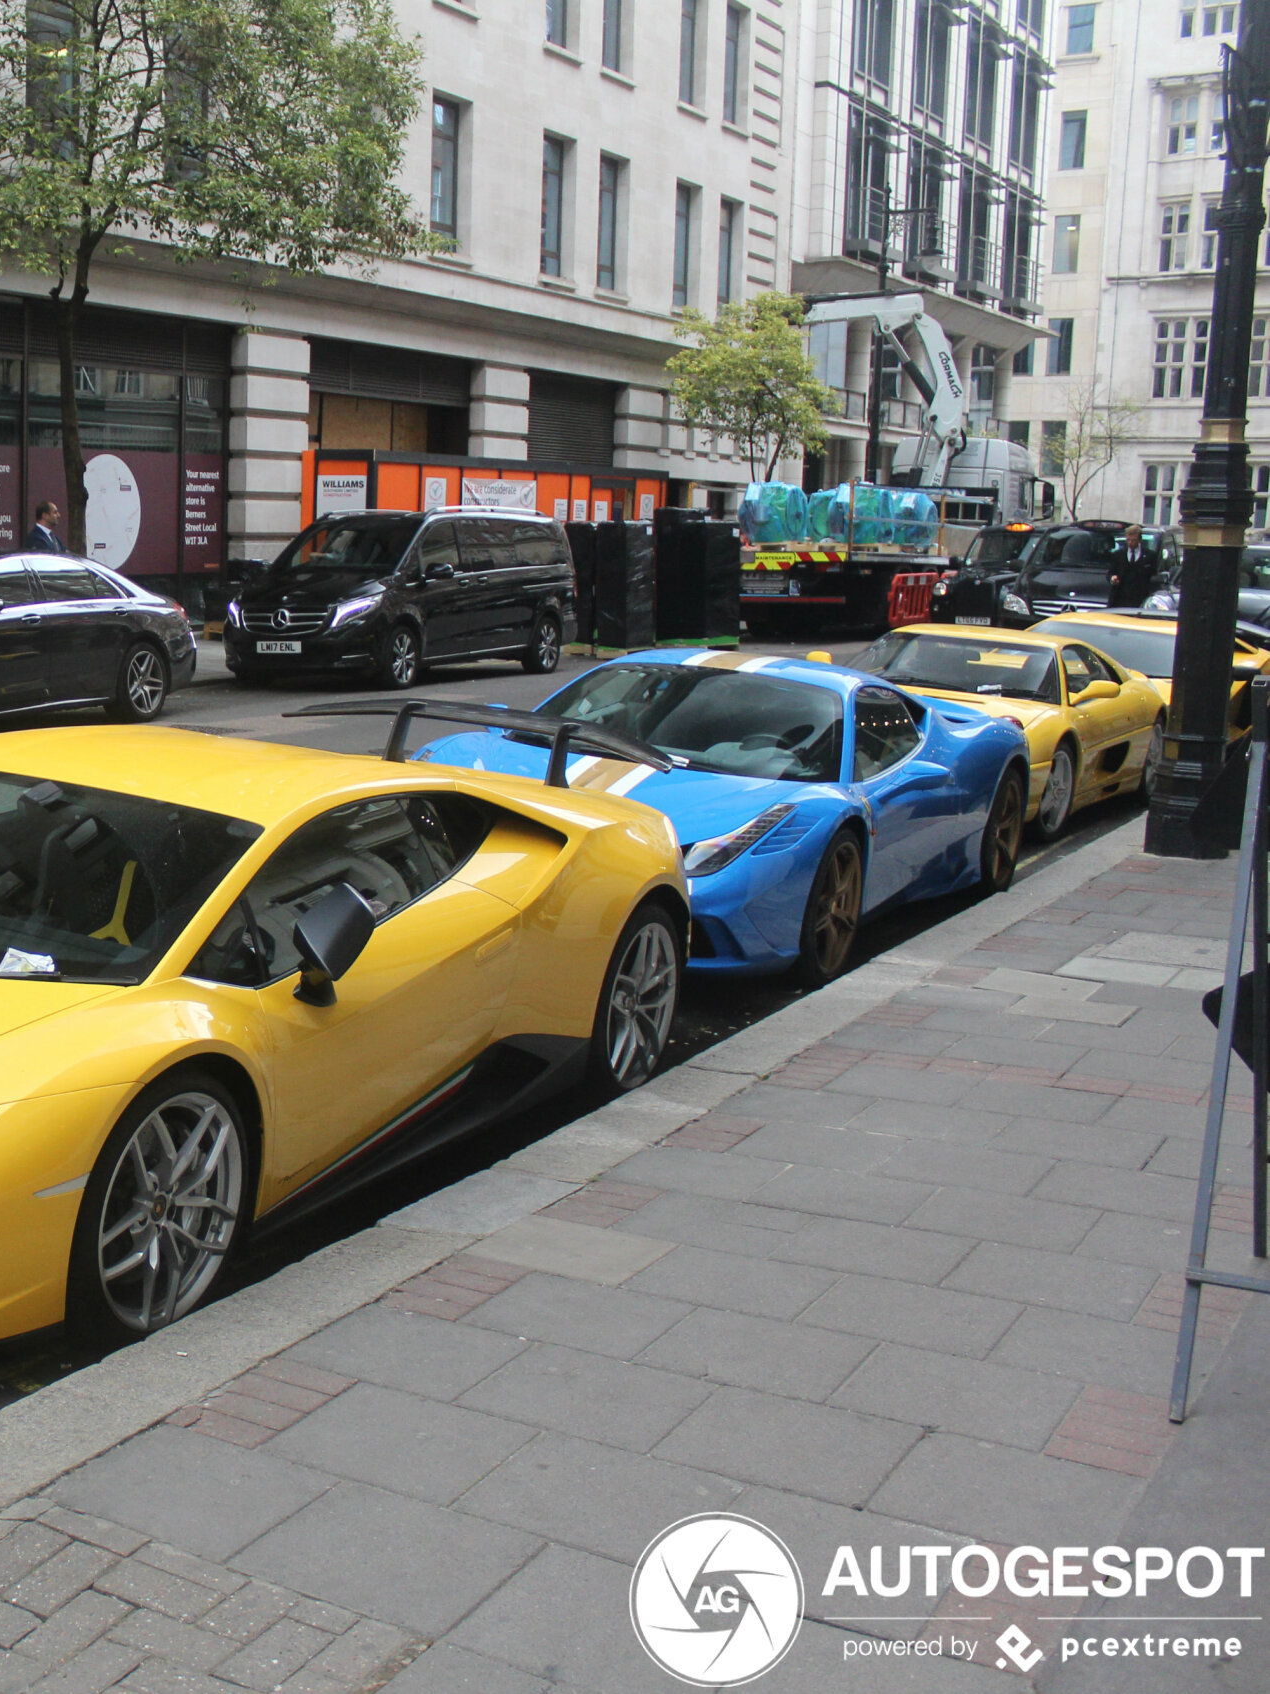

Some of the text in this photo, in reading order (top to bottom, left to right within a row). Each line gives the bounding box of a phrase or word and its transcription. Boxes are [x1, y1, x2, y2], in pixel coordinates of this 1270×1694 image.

[938, 351, 963, 399] CORMACH
[185, 469, 220, 480] Your nearest
[185, 483, 215, 493] alternative
[322, 480, 365, 488] WILLIAMS
[483, 483, 517, 495] considerate
[185, 496, 206, 506] store is
[185, 510, 206, 519] Berners
[185, 523, 217, 532] Street Local
[198, 536, 208, 545] 3LA
